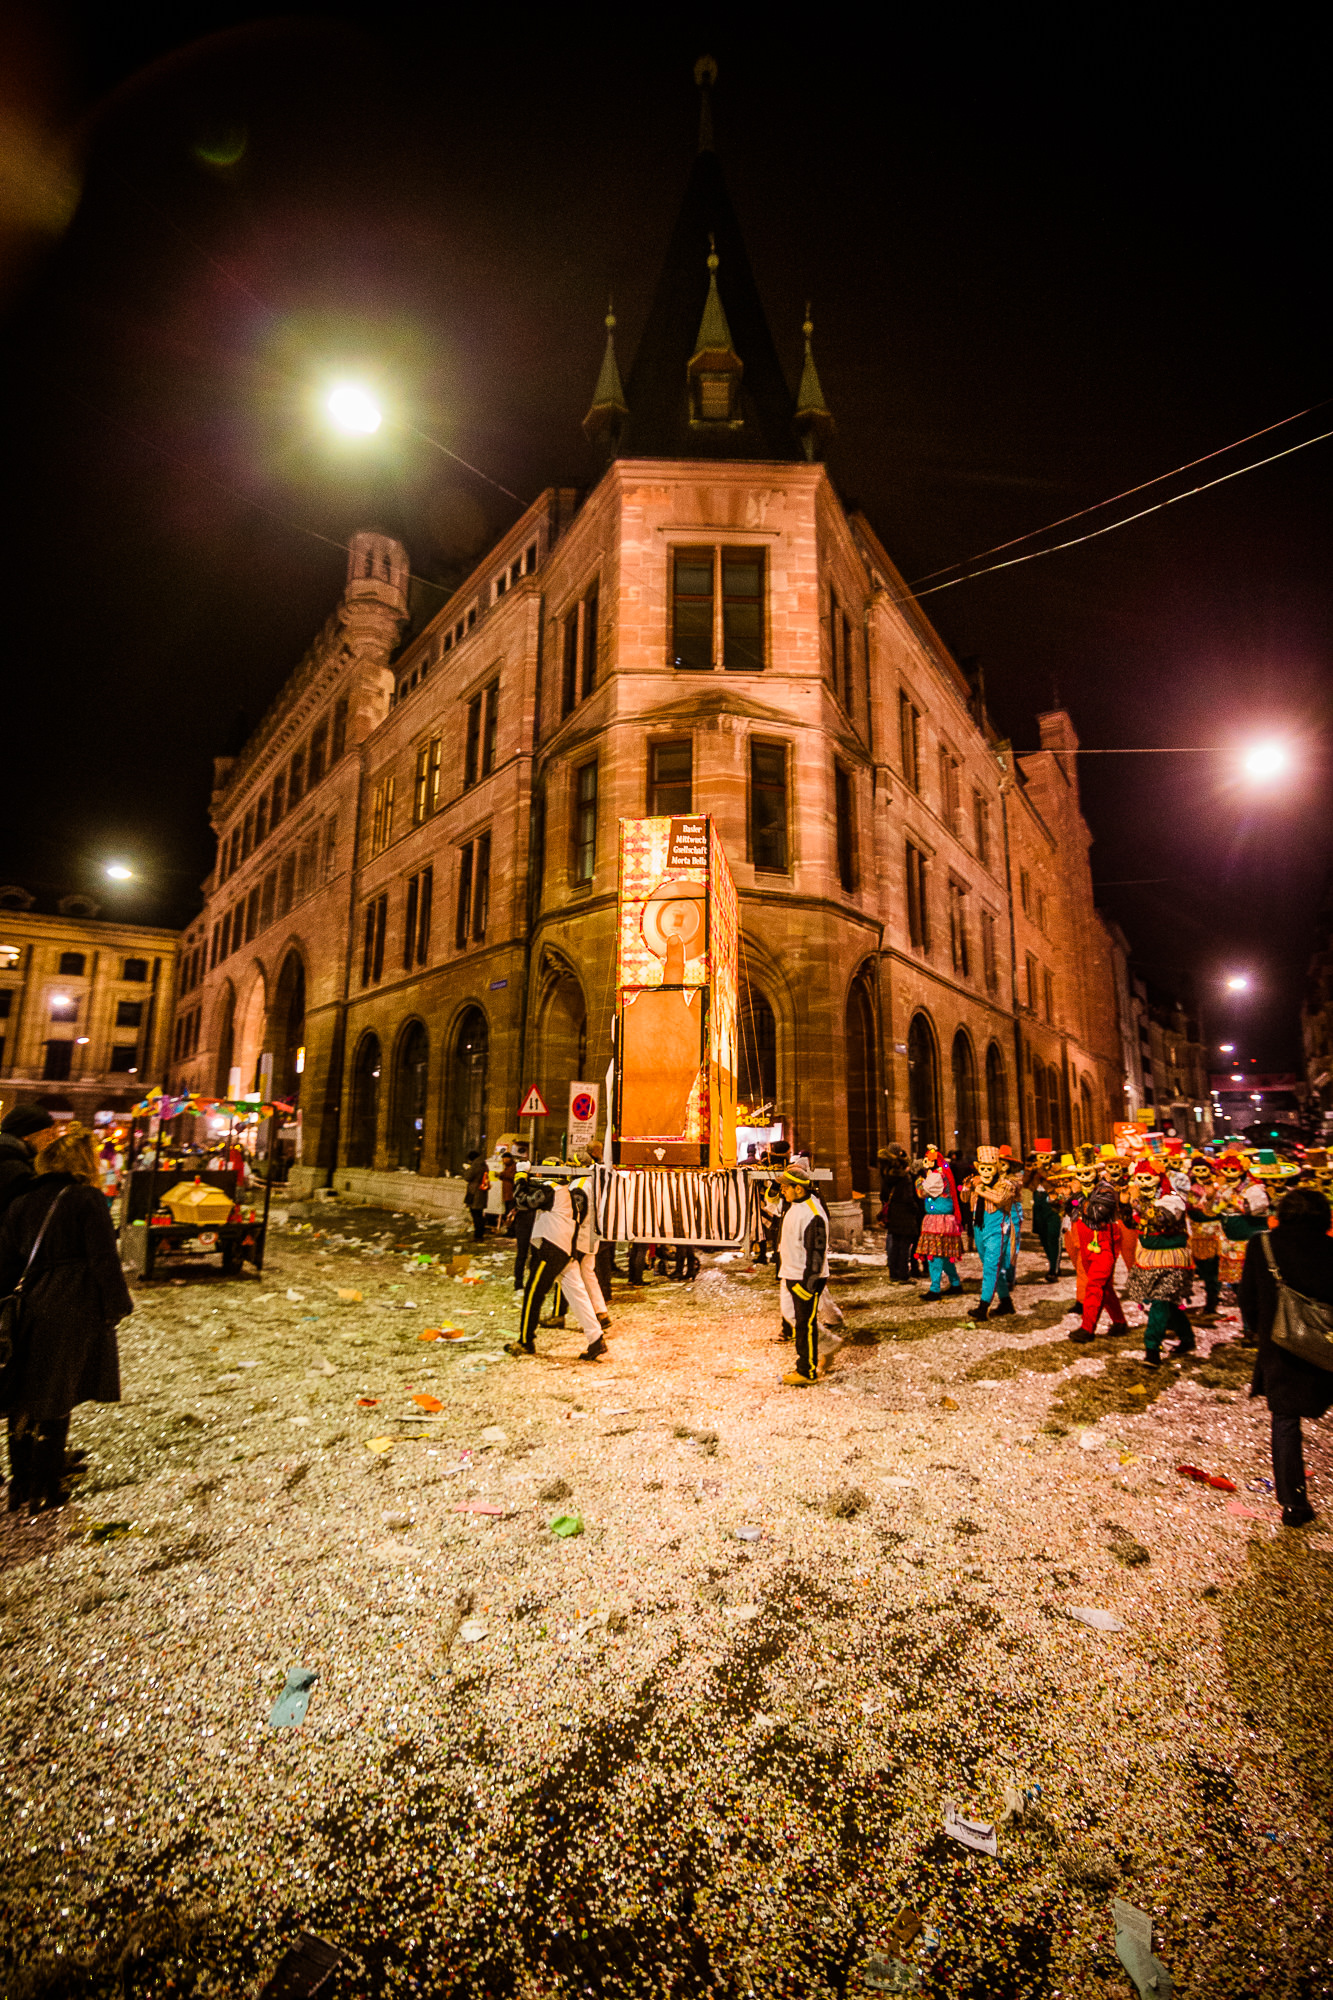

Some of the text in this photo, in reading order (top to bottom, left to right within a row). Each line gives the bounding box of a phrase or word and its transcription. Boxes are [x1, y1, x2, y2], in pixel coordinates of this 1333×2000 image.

[682, 824, 702, 833] Basler
[673, 845, 707, 854] Gsellschaft
[671, 856, 707, 866] Morta Bella
